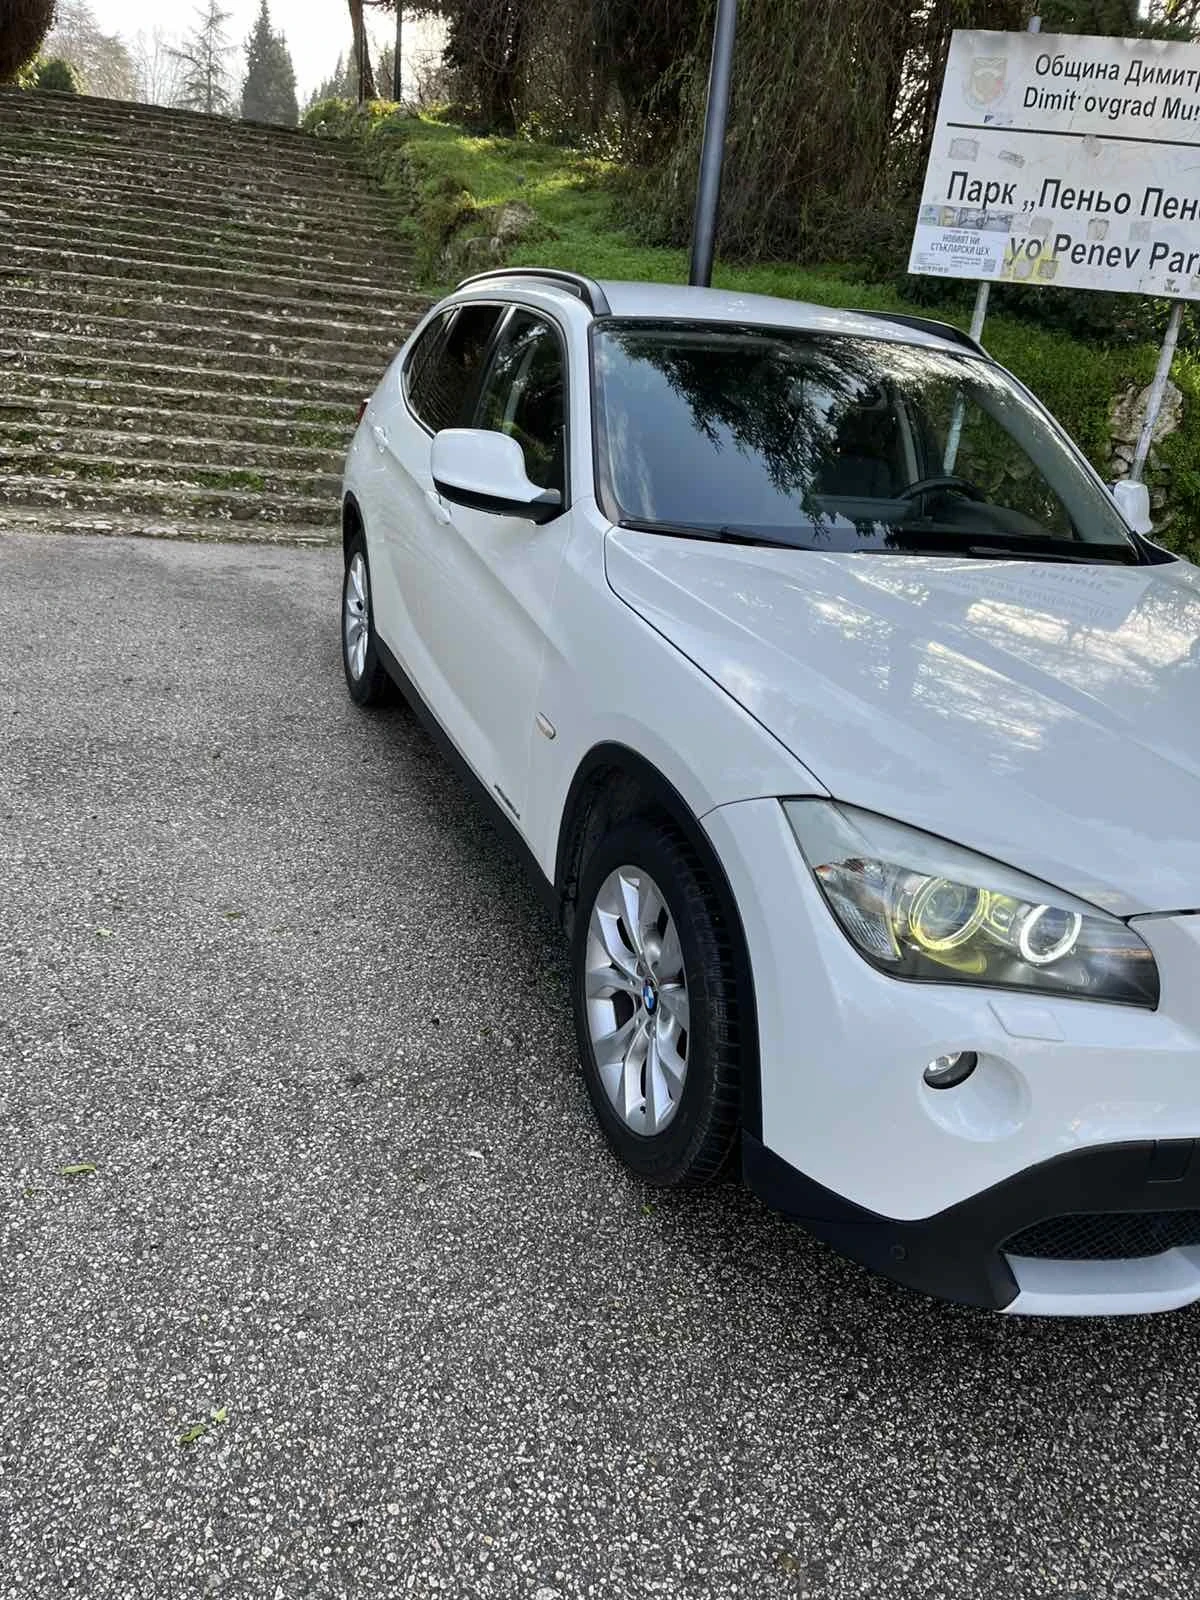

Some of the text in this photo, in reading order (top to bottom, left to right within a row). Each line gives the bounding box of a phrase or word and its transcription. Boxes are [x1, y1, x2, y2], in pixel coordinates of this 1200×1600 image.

[1035, 53, 1120, 82] Община
[1023, 86, 1158, 120] Dimitovgrad
[947, 171, 1017, 209] Парк
[1141, 187, 1200, 220] Пен
[1052, 233, 1140, 268] Penev
[1149, 241, 1200, 275] Par
